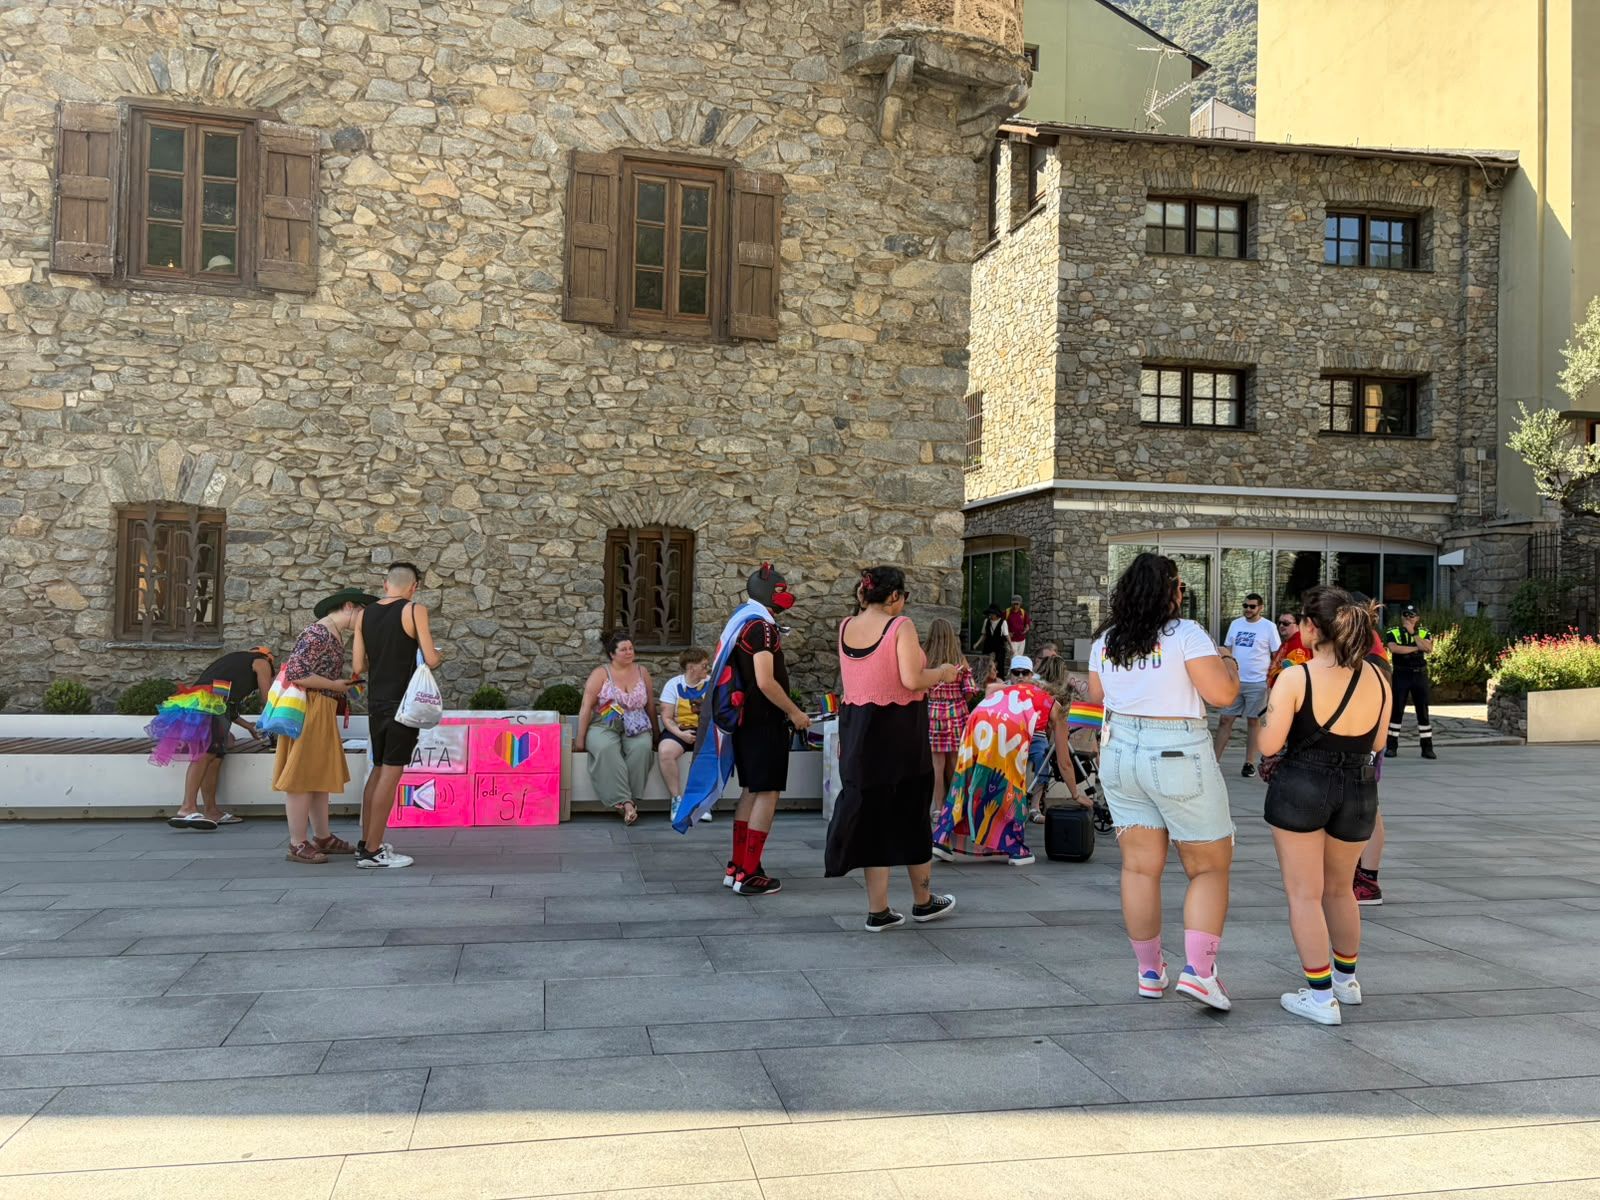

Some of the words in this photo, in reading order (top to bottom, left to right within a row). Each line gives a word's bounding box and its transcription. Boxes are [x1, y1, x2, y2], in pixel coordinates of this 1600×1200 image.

[1092, 501, 1198, 514] TRIBUNAL
[1233, 505, 1411, 523] CONSTITUCIONAL
[407, 746, 452, 769] ATA
